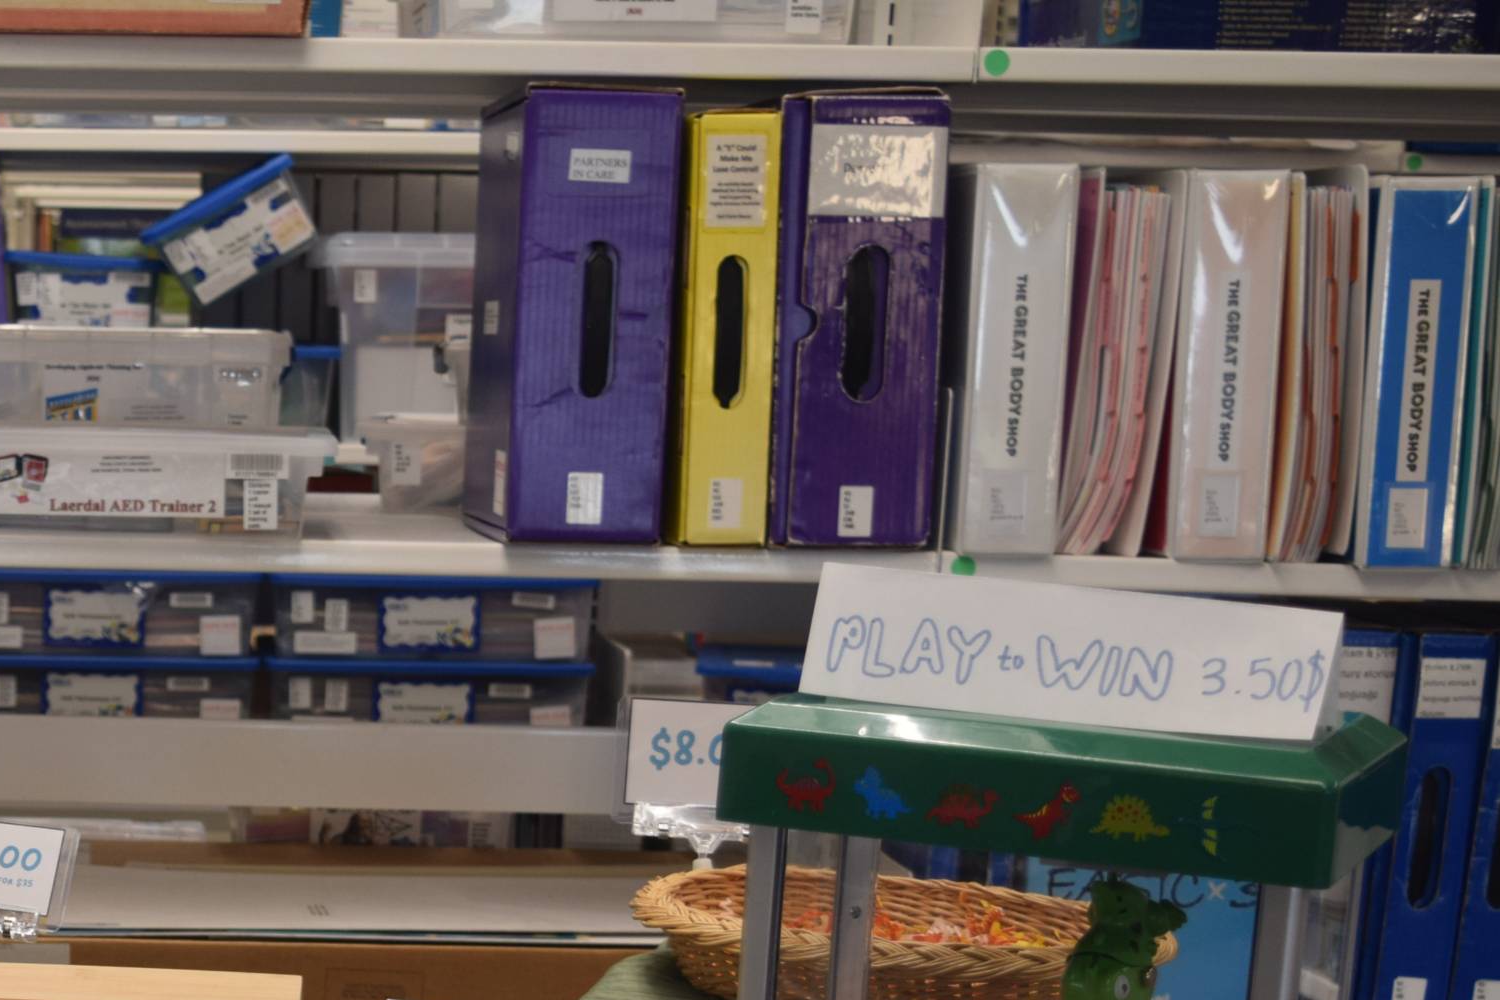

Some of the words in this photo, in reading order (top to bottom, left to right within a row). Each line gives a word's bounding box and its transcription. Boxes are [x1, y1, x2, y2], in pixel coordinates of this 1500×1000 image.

[573, 157, 628, 168] PARTNERS
[573, 169, 584, 177] IN
[586, 170, 615, 179] CARE
[1015, 274, 1028, 301] THE
[1228, 280, 1240, 306] THE
[1418, 289, 1430, 316] THE
[1011, 305, 1028, 360] GREAT
[1224, 310, 1240, 366] GREAT
[1414, 320, 1430, 376] GREAT
[1009, 367, 1024, 416] BODY
[1220, 372, 1236, 420] BODY
[1410, 382, 1425, 431] BODY
[1005, 417, 1019, 457] SHOP
[1218, 422, 1231, 462] SHOP
[1407, 433, 1419, 472] SHOP
[49, 499, 106, 513] Laerdal
[109, 500, 145, 513] AED
[148, 500, 204, 513] Trainer
[207, 501, 217, 513] 2
[826, 615, 991, 685] PLAY
[997, 645, 1025, 672] to
[1036, 634, 1175, 700] WIN
[1200, 649, 1325, 712] 3.50$
